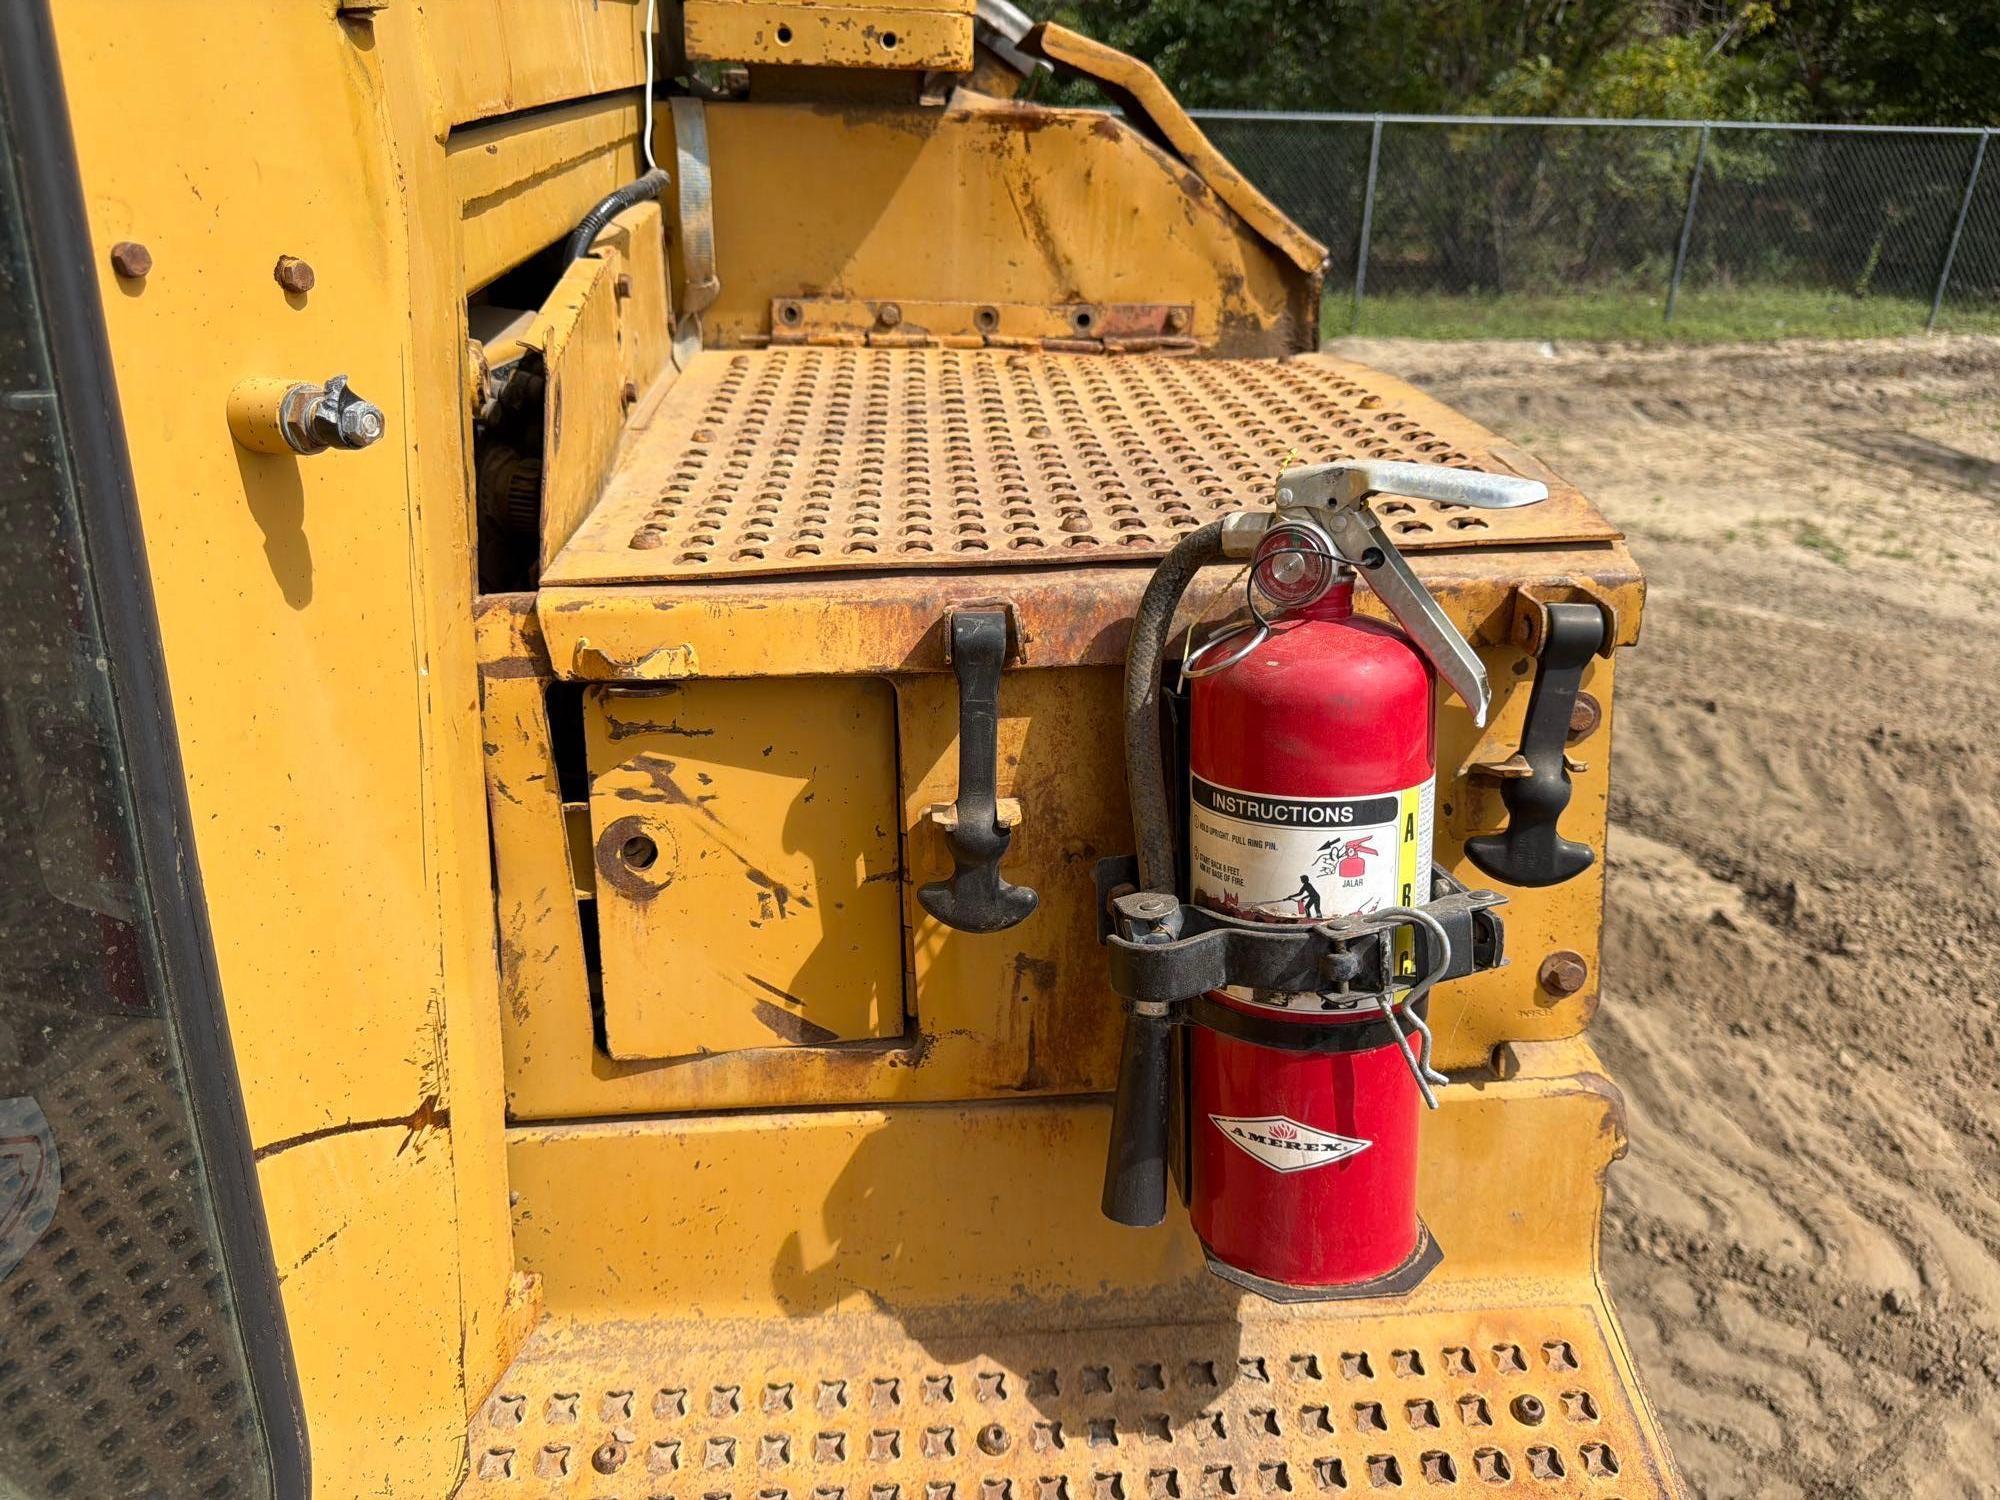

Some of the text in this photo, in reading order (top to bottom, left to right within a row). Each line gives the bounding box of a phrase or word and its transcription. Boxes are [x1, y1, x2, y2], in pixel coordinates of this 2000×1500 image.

[1212, 791, 1354, 823] INSTRUCTIONS
[1404, 812, 1414, 843] A
[1231, 834, 1246, 846] PULL
[1247, 838, 1263, 849] RING
[1211, 859, 1222, 871] BACK
[1212, 868, 1223, 881] BASE
[1223, 873, 1231, 882] OF
[1342, 879, 1364, 888] JALAR
[1231, 1126, 1342, 1152] AMEREX
